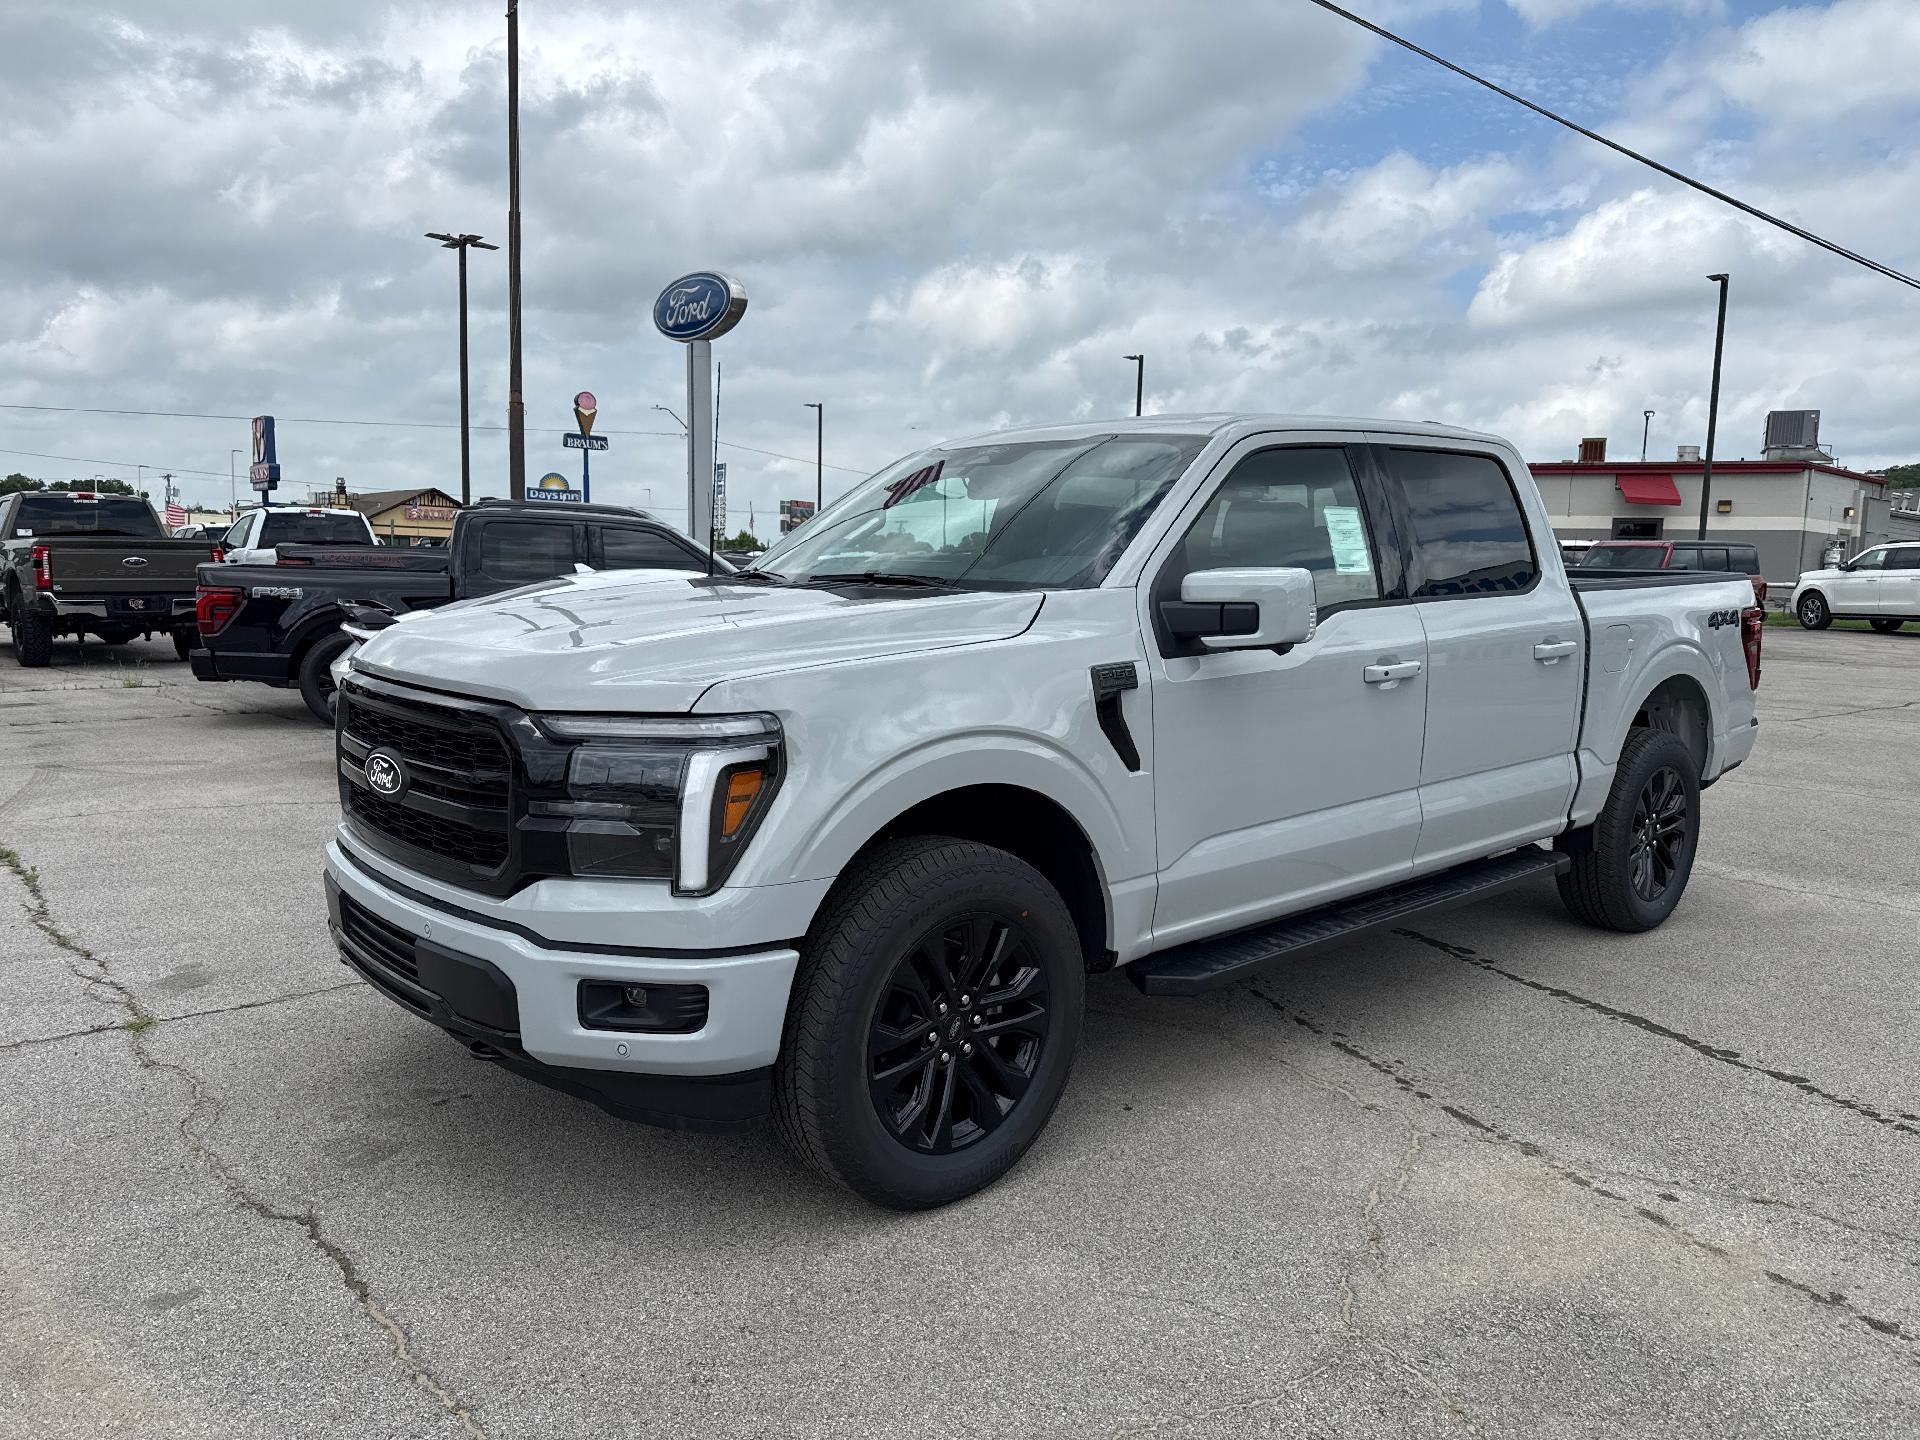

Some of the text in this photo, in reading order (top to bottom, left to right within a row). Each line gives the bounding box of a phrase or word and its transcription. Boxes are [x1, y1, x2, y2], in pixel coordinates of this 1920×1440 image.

[666, 285, 711, 328] Ford
[529, 489, 559, 500] Days
[252, 586, 304, 600] FX4
[370, 758, 394, 788] Ford
